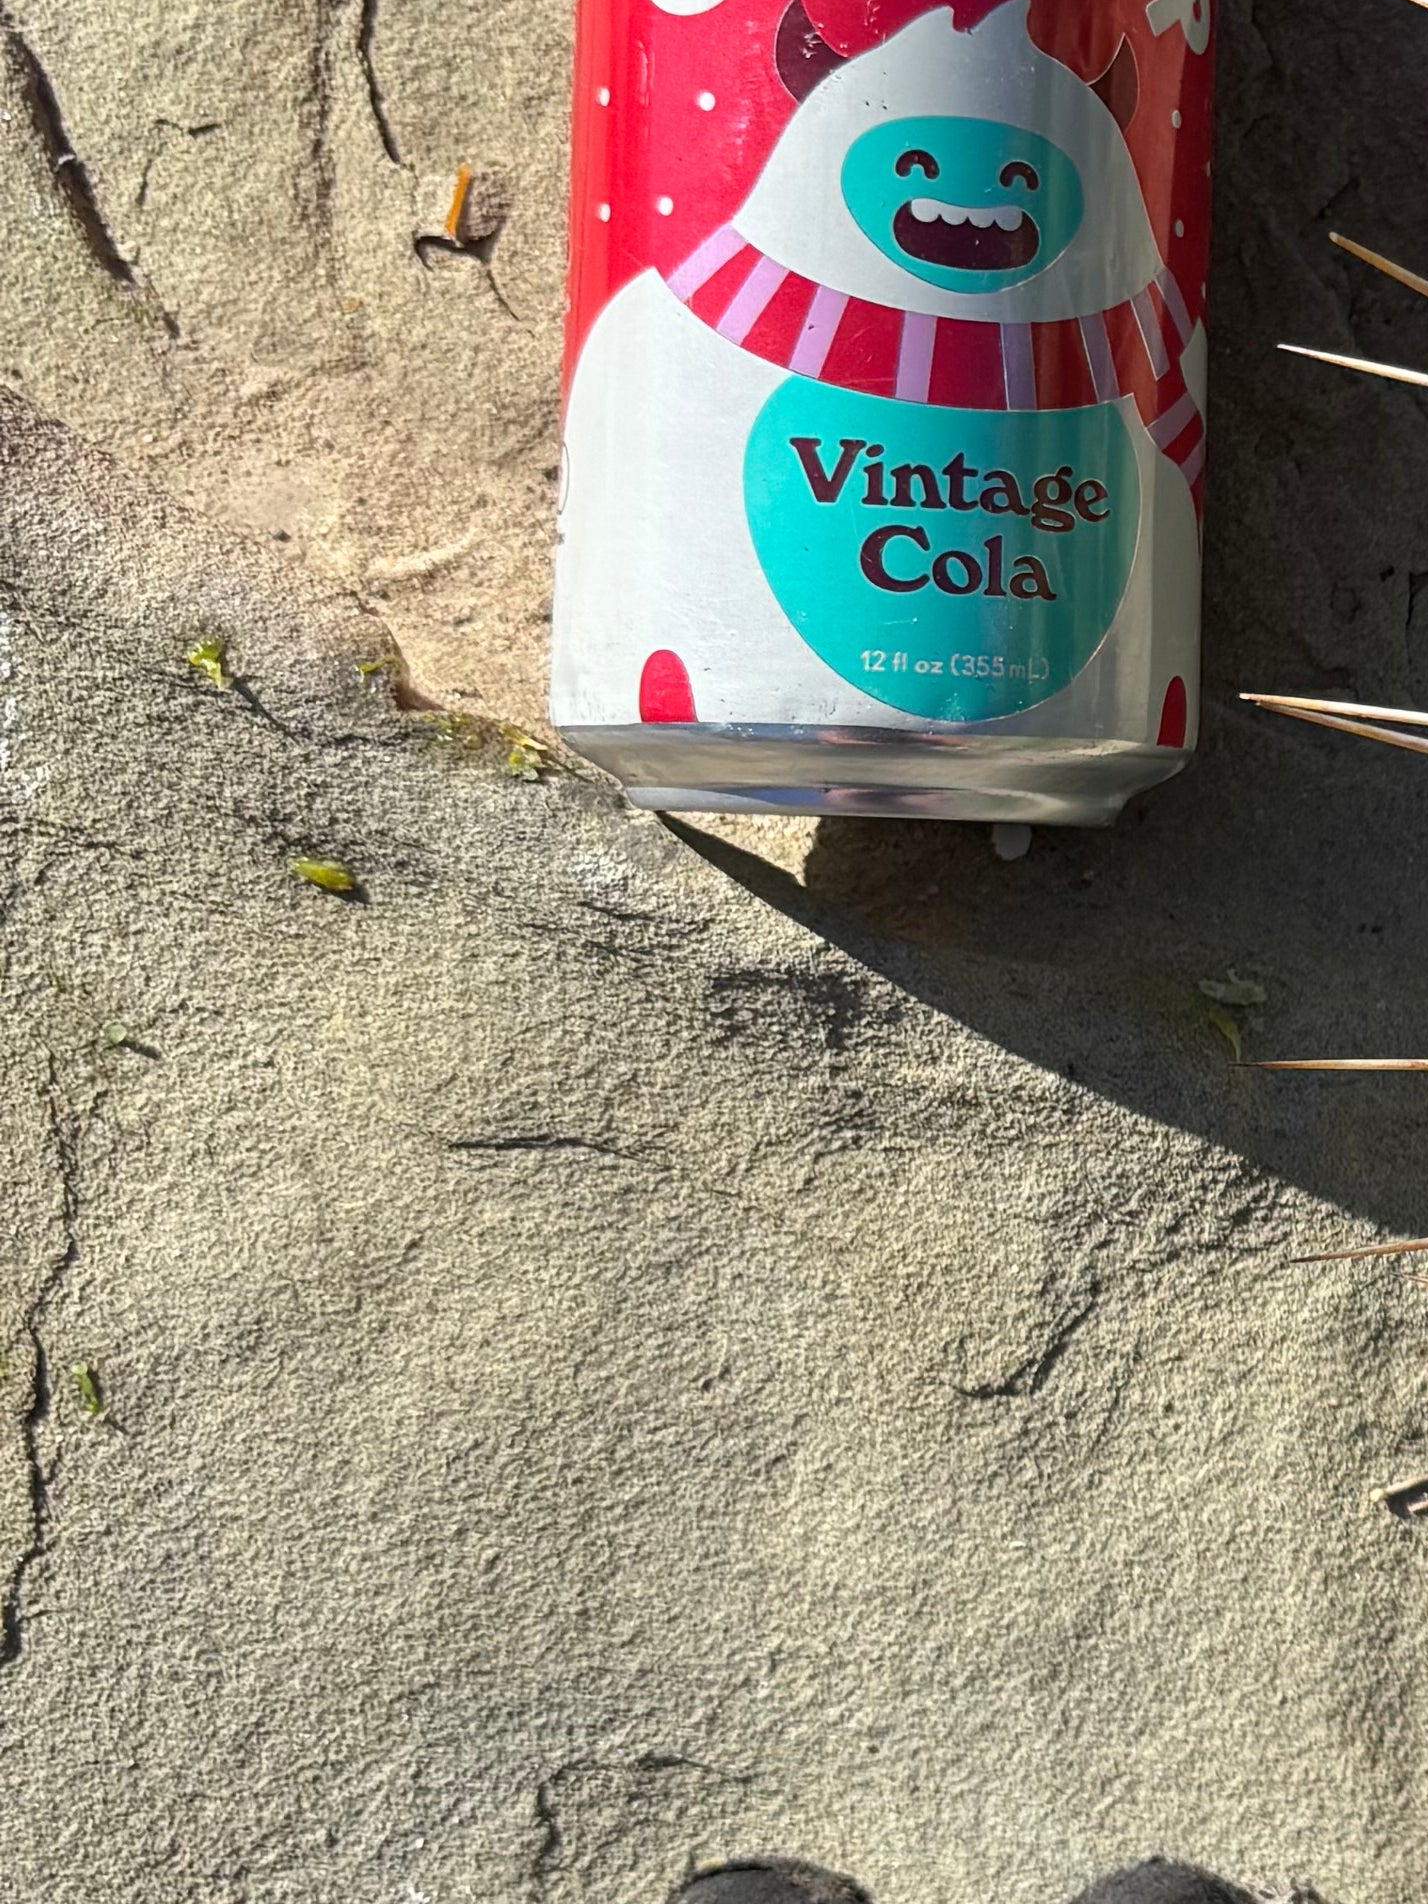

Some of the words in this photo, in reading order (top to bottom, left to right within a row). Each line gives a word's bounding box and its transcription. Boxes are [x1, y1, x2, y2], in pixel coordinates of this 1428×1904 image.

[789, 437, 1110, 533] Vintage
[859, 524, 1058, 601] Cola
[860, 650, 886, 672] 12
[892, 651, 907, 673] fl
[914, 660, 944, 675] oz
[950, 653, 1005, 677] (355
[1009, 657, 1048, 680] mL)
